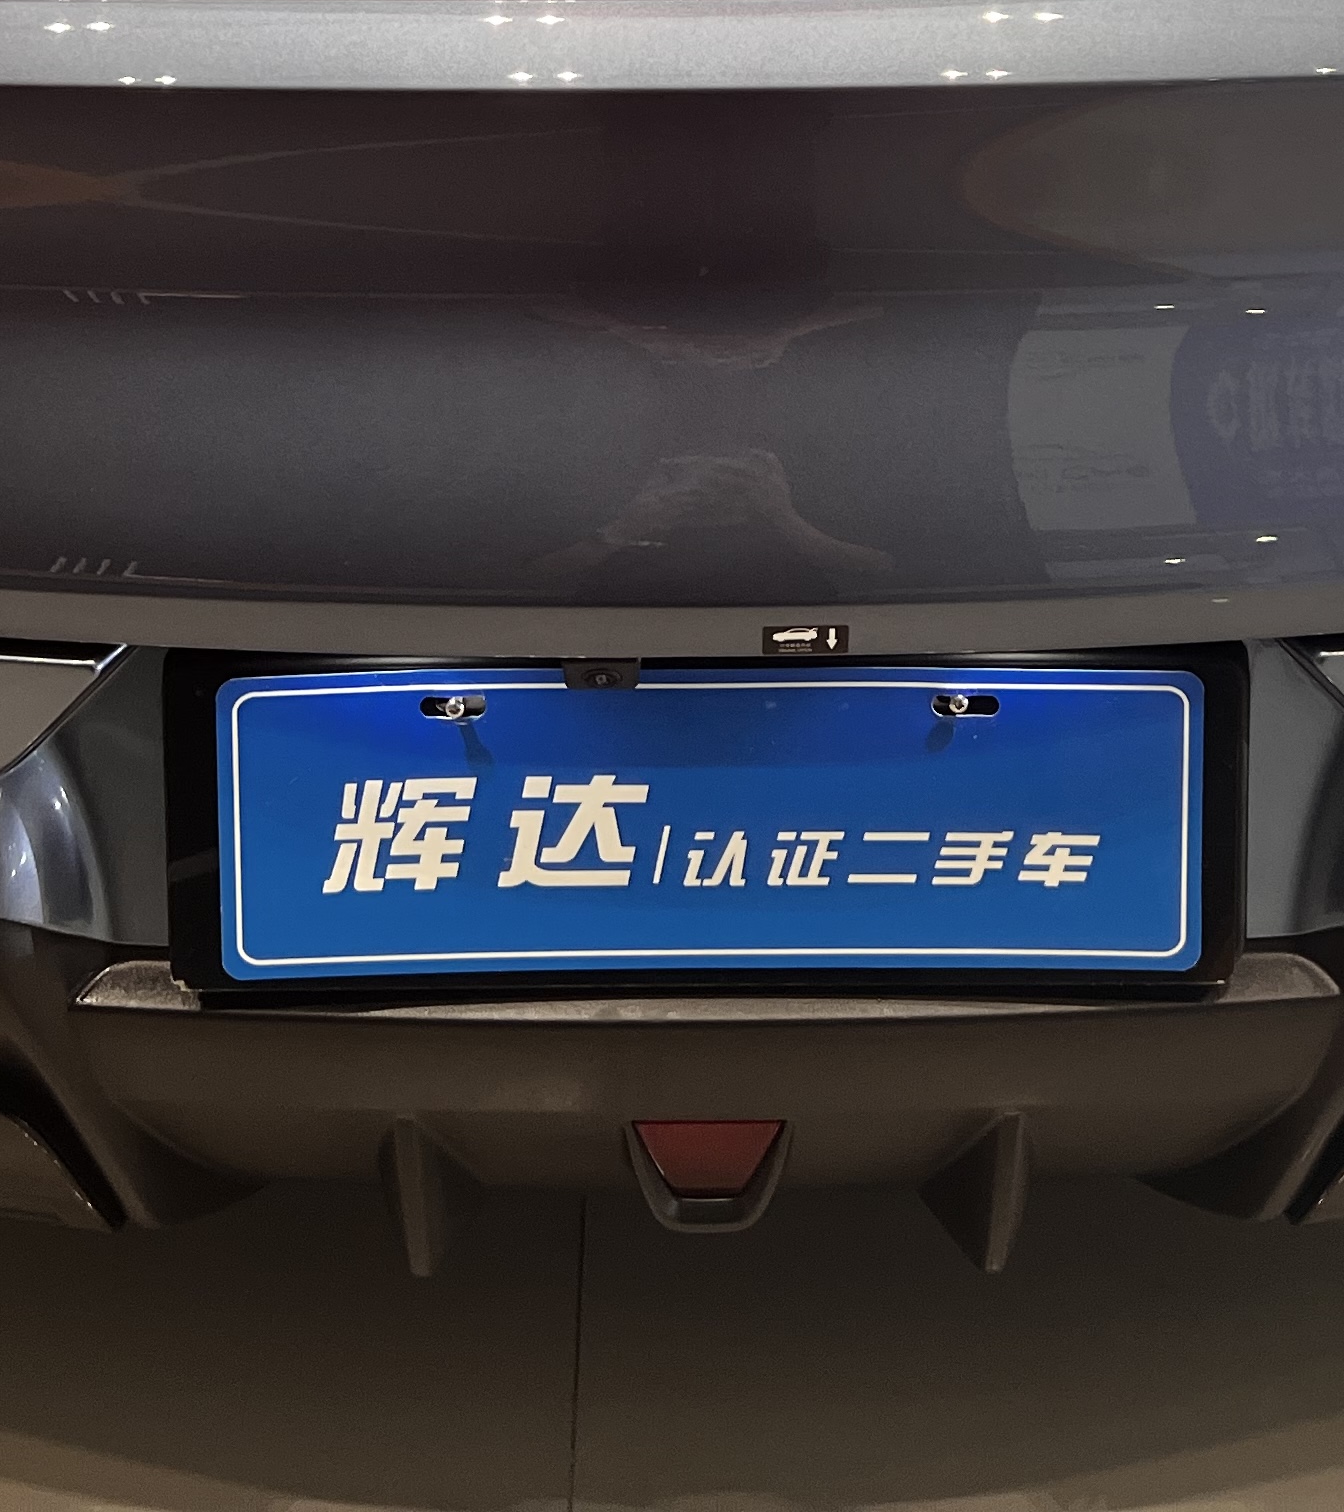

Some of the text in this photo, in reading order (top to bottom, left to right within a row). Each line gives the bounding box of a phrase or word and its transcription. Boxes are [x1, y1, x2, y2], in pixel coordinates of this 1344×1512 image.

[322, 774, 1101, 894] 辉达 认证二手车
